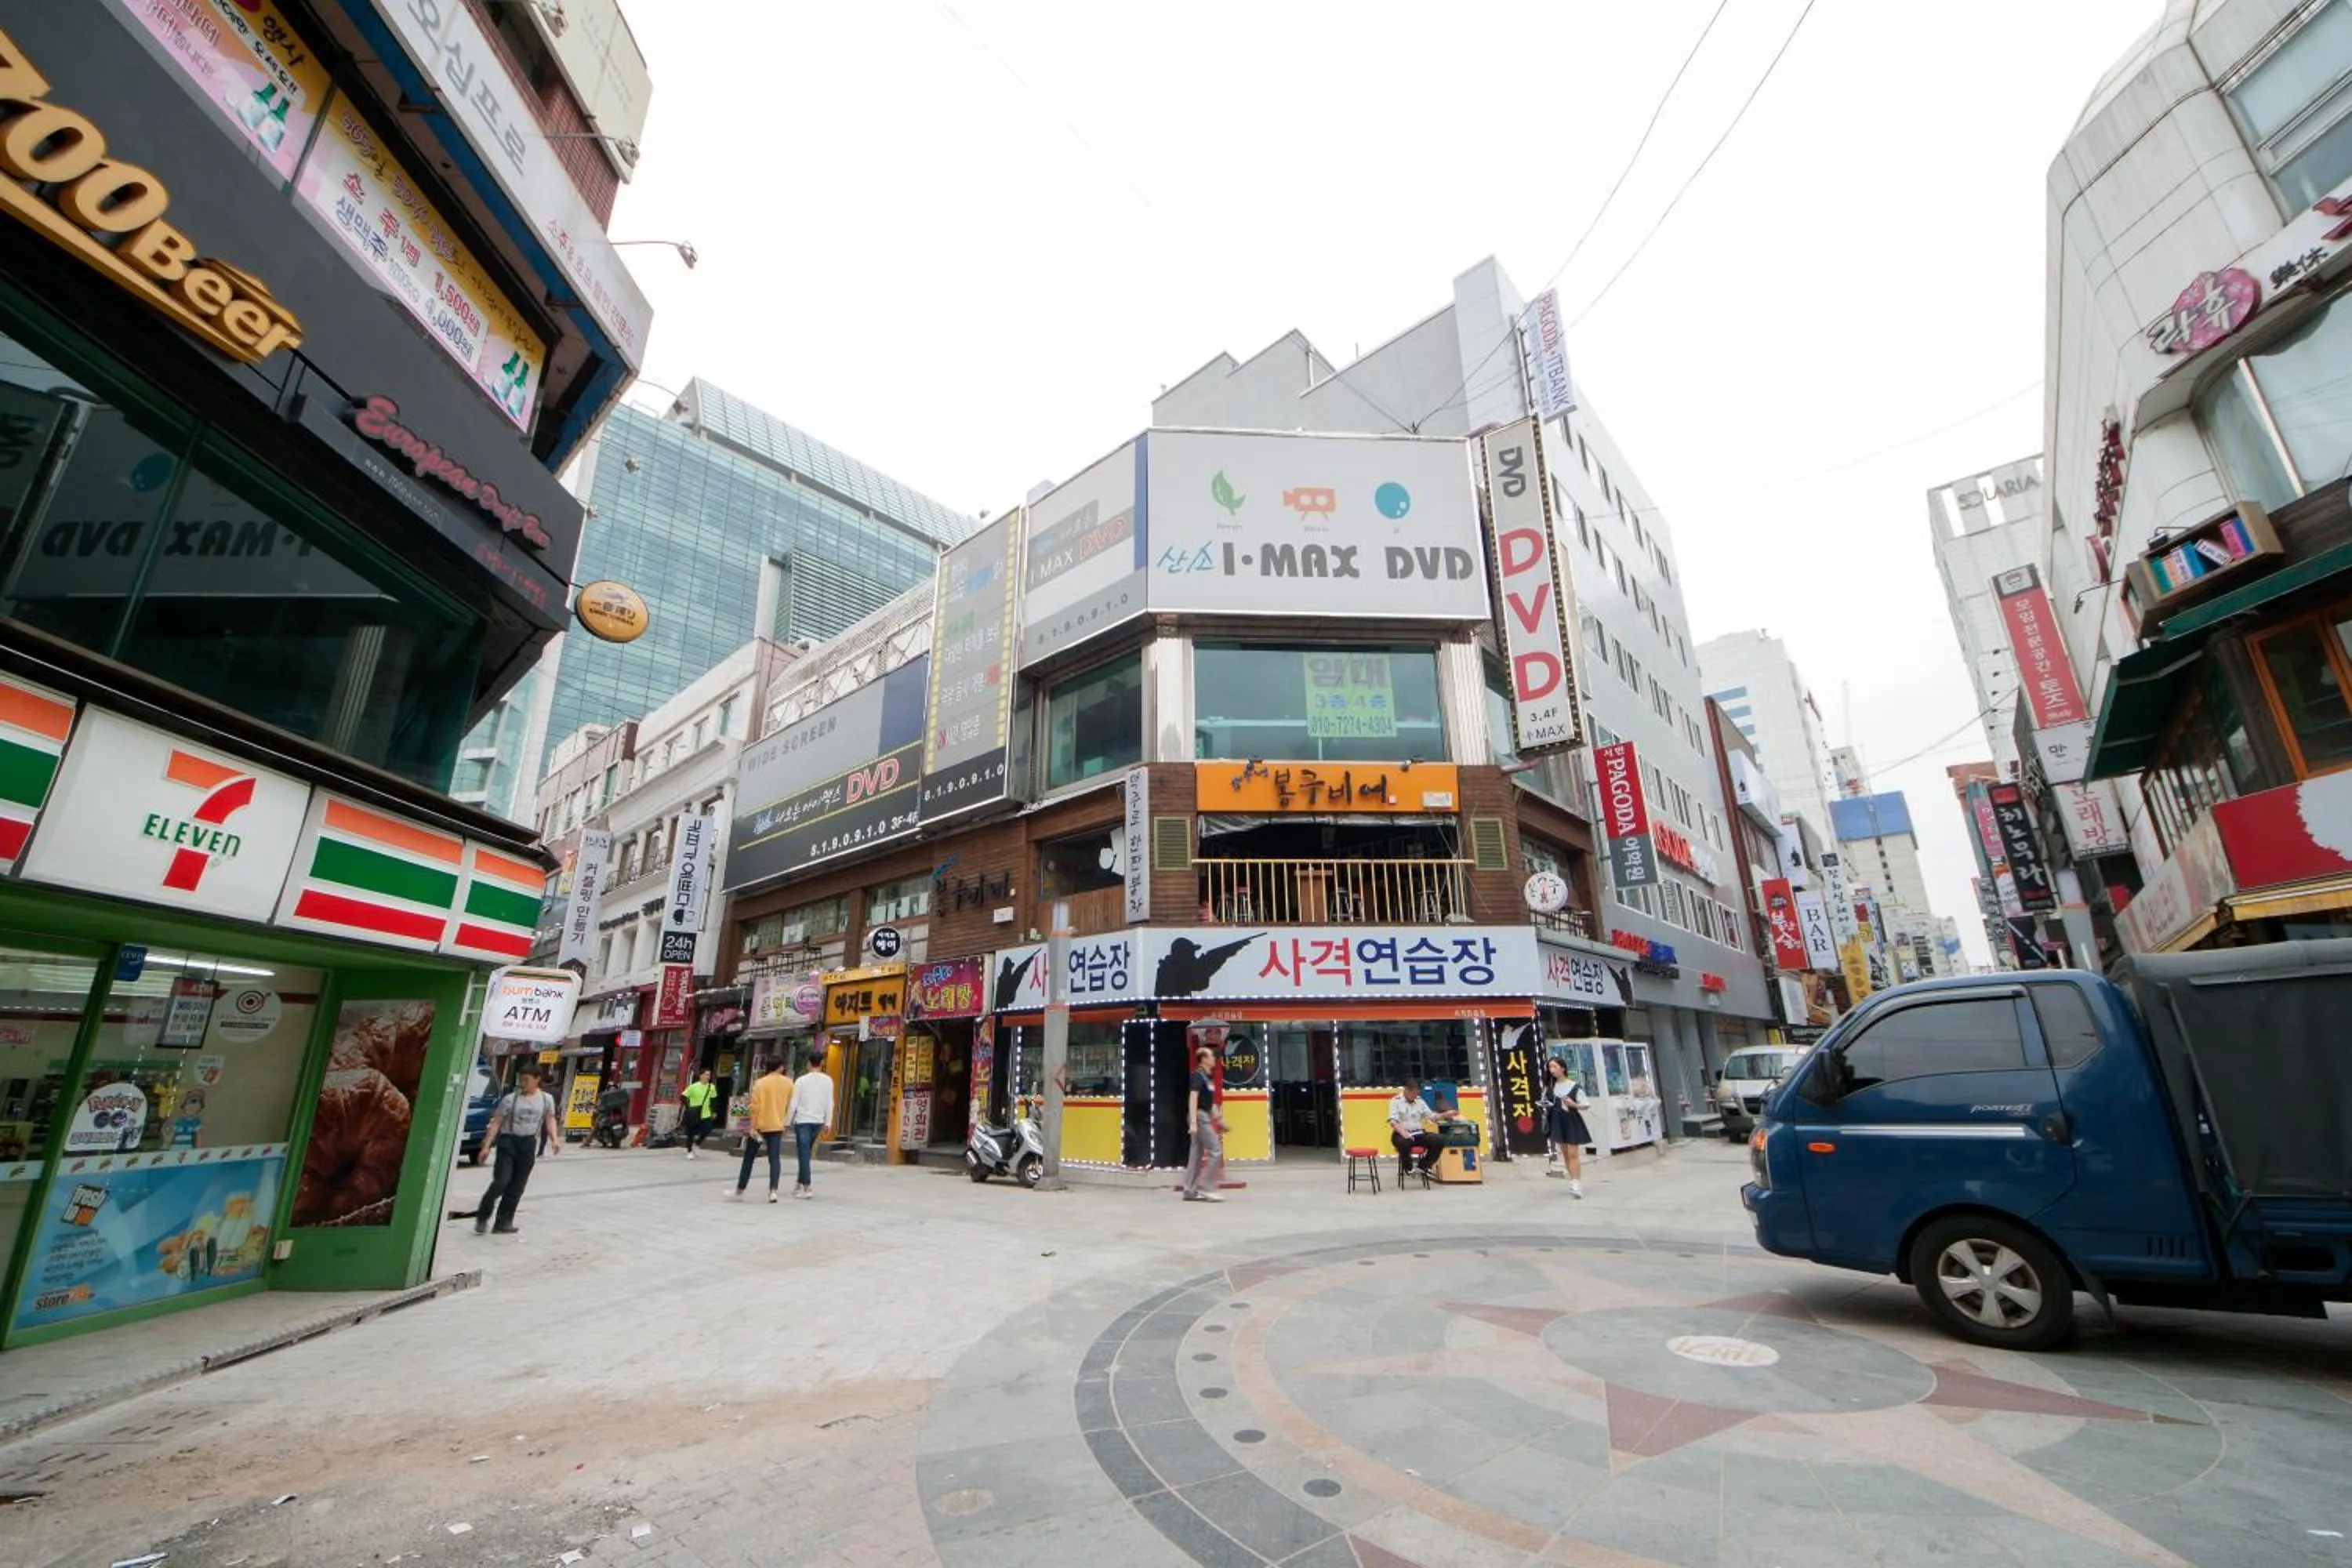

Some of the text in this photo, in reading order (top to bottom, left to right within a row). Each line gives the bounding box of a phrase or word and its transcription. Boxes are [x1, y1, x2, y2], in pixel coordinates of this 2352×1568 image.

[336, 196, 388, 264] 생맥주
[1498, 445, 1527, 499] DVD
[1385, 546, 1474, 581] DVD
[1498, 527, 1563, 703] DVD
[747, 716, 838, 773] WIDE SCREEN
[846, 758, 900, 804] DVD
[1275, 768, 1387, 807] 봉구비어
[1608, 757, 1637, 837] PAGODA
[1623, 837, 1646, 883] 어학원
[571, 905, 590, 946] 만들기
[665, 935, 693, 950] 24h
[1805, 908, 1828, 952] BAR
[664, 949, 691, 961] OPEN
[1028, 940, 1132, 996] 사연습장
[1259, 936, 1497, 988] 사격연습장
[1546, 953, 1604, 996] 사격연습장
[504, 1005, 552, 1023] ATM
